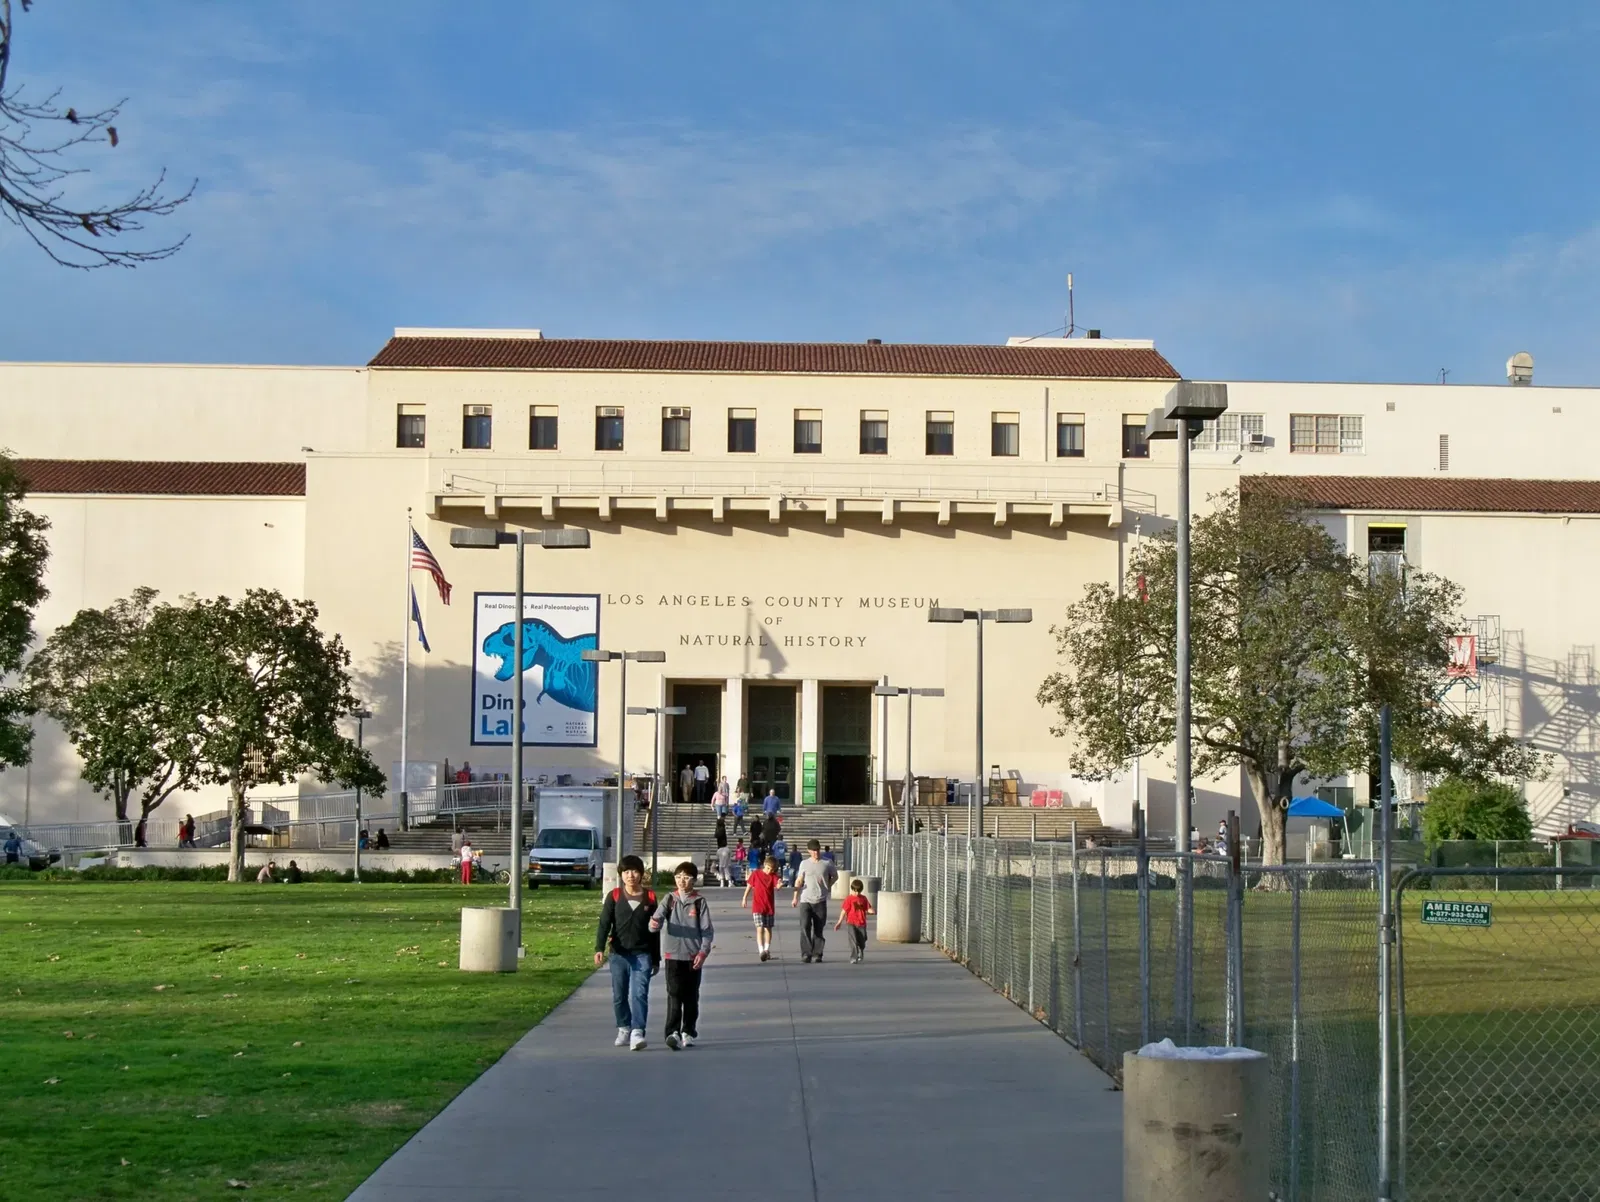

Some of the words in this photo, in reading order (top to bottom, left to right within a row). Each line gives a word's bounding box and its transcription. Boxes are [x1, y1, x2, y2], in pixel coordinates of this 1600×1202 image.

[607, 594, 645, 606] LOS
[658, 594, 751, 607] ANGELES
[764, 596, 843, 608] COUNTY
[858, 597, 940, 609] MUSEUM
[544, 604, 589, 612] Paleontologists
[764, 616, 783, 626] OF
[679, 634, 768, 647] NATURAL
[784, 636, 867, 648] HISTORY
[1427, 903, 1488, 912] AMERICAN
